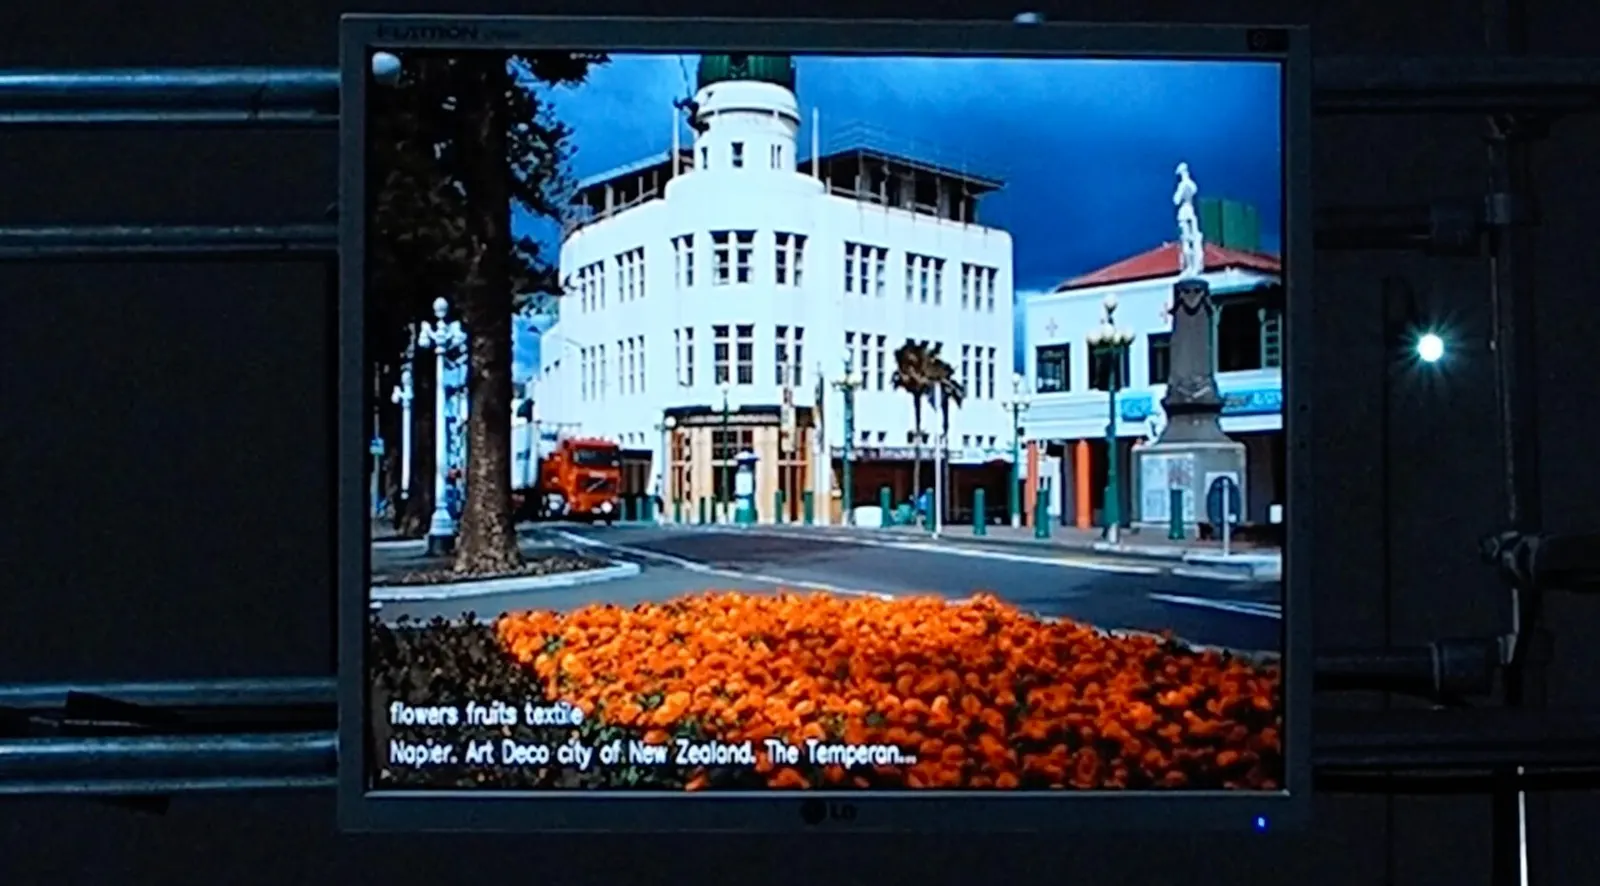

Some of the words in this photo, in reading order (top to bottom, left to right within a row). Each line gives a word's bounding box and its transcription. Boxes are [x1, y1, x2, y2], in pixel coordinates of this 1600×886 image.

[390, 702, 459, 725] flowers
[465, 702, 518, 725] fruits
[524, 701, 583, 725] textile
[390, 738, 457, 768] Napier.
[465, 740, 495, 764] Art
[502, 740, 550, 764] Deco
[557, 737, 593, 770] city
[599, 739, 621, 764] of
[629, 740, 668, 764] New
[675, 738, 756, 764] Zealand.
[764, 739, 799, 763] The
